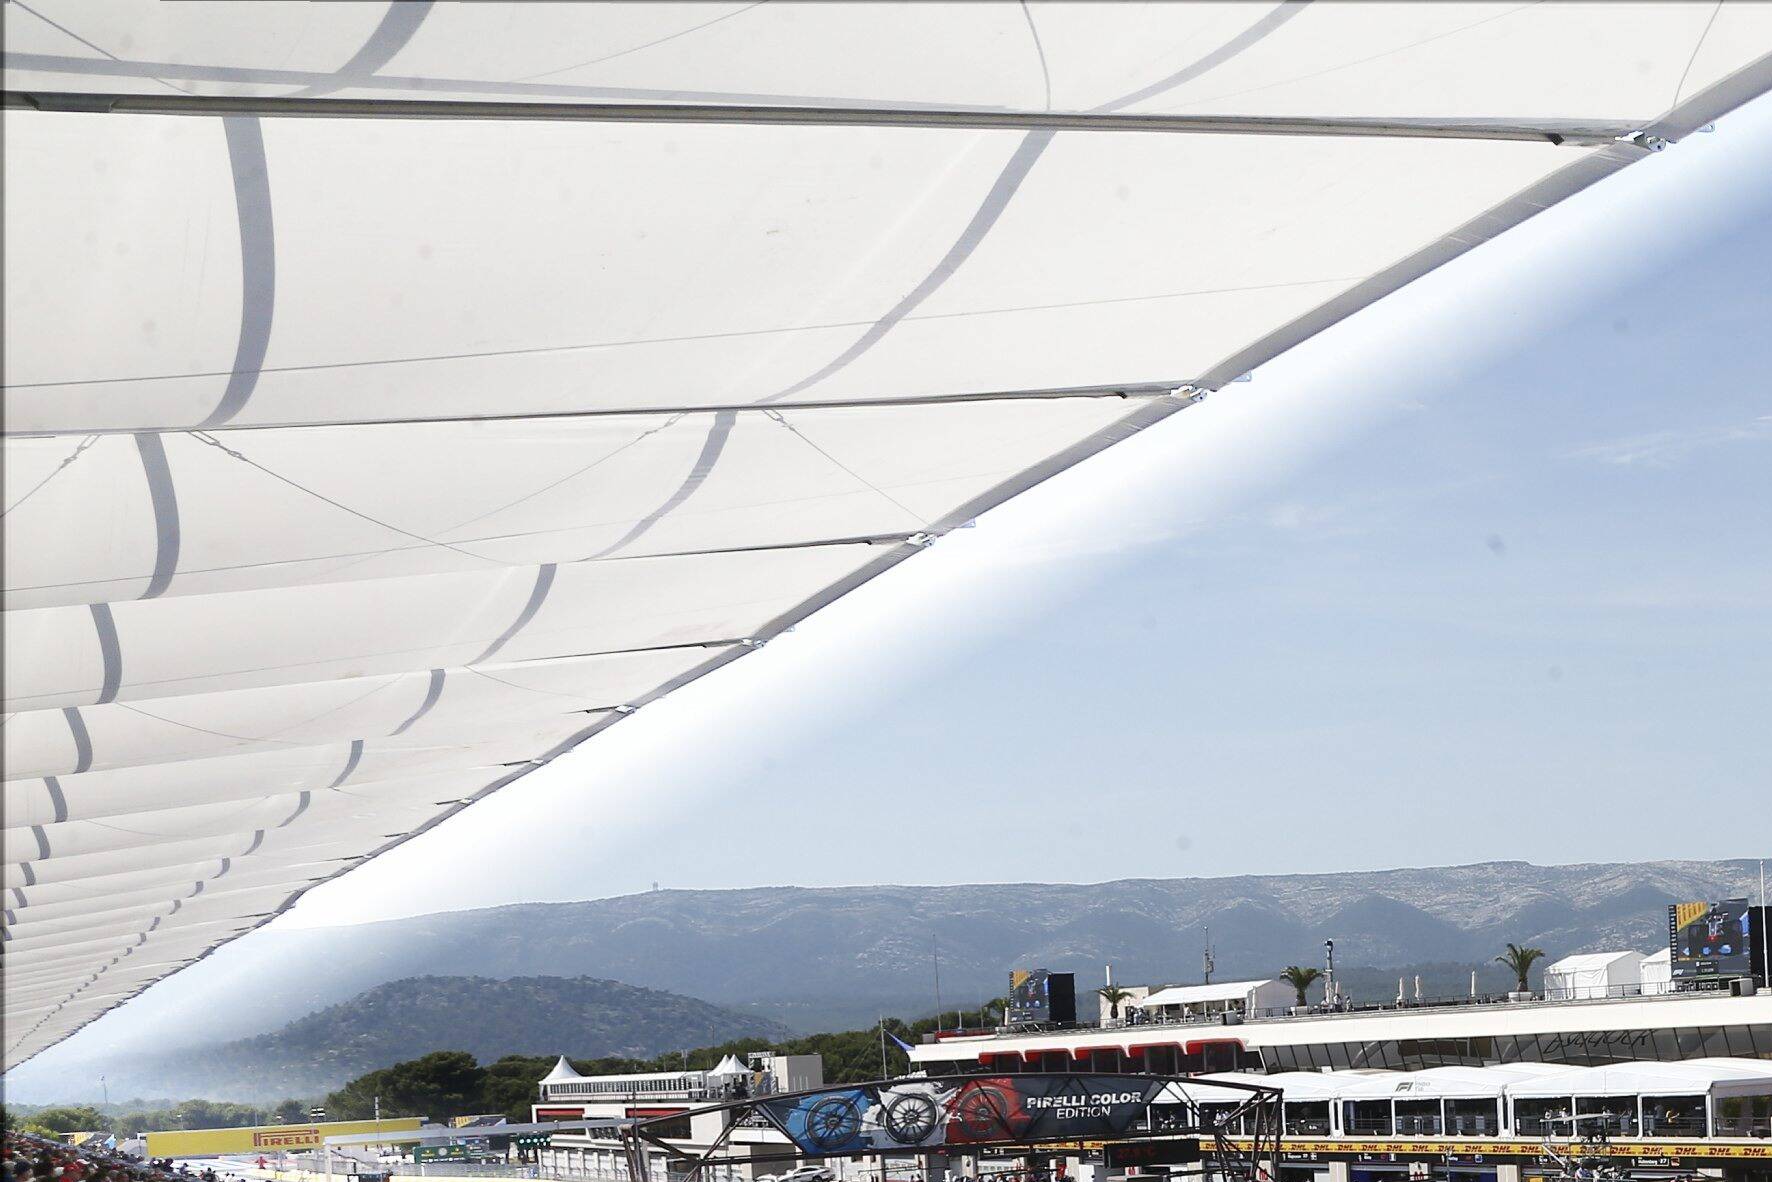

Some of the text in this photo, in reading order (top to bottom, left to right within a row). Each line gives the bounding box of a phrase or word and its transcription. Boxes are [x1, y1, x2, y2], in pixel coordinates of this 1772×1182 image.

[1395, 1082, 1414, 1091] F1
[1026, 1092, 1142, 1109] PIRELLI COLOR
[1056, 1106, 1111, 1120] EDITION
[253, 1129, 319, 1147] PIRELLI
[1611, 1146, 1631, 1154] DHL
[1708, 1148, 1732, 1156] DHL
[1742, 1148, 1766, 1156] DHL
